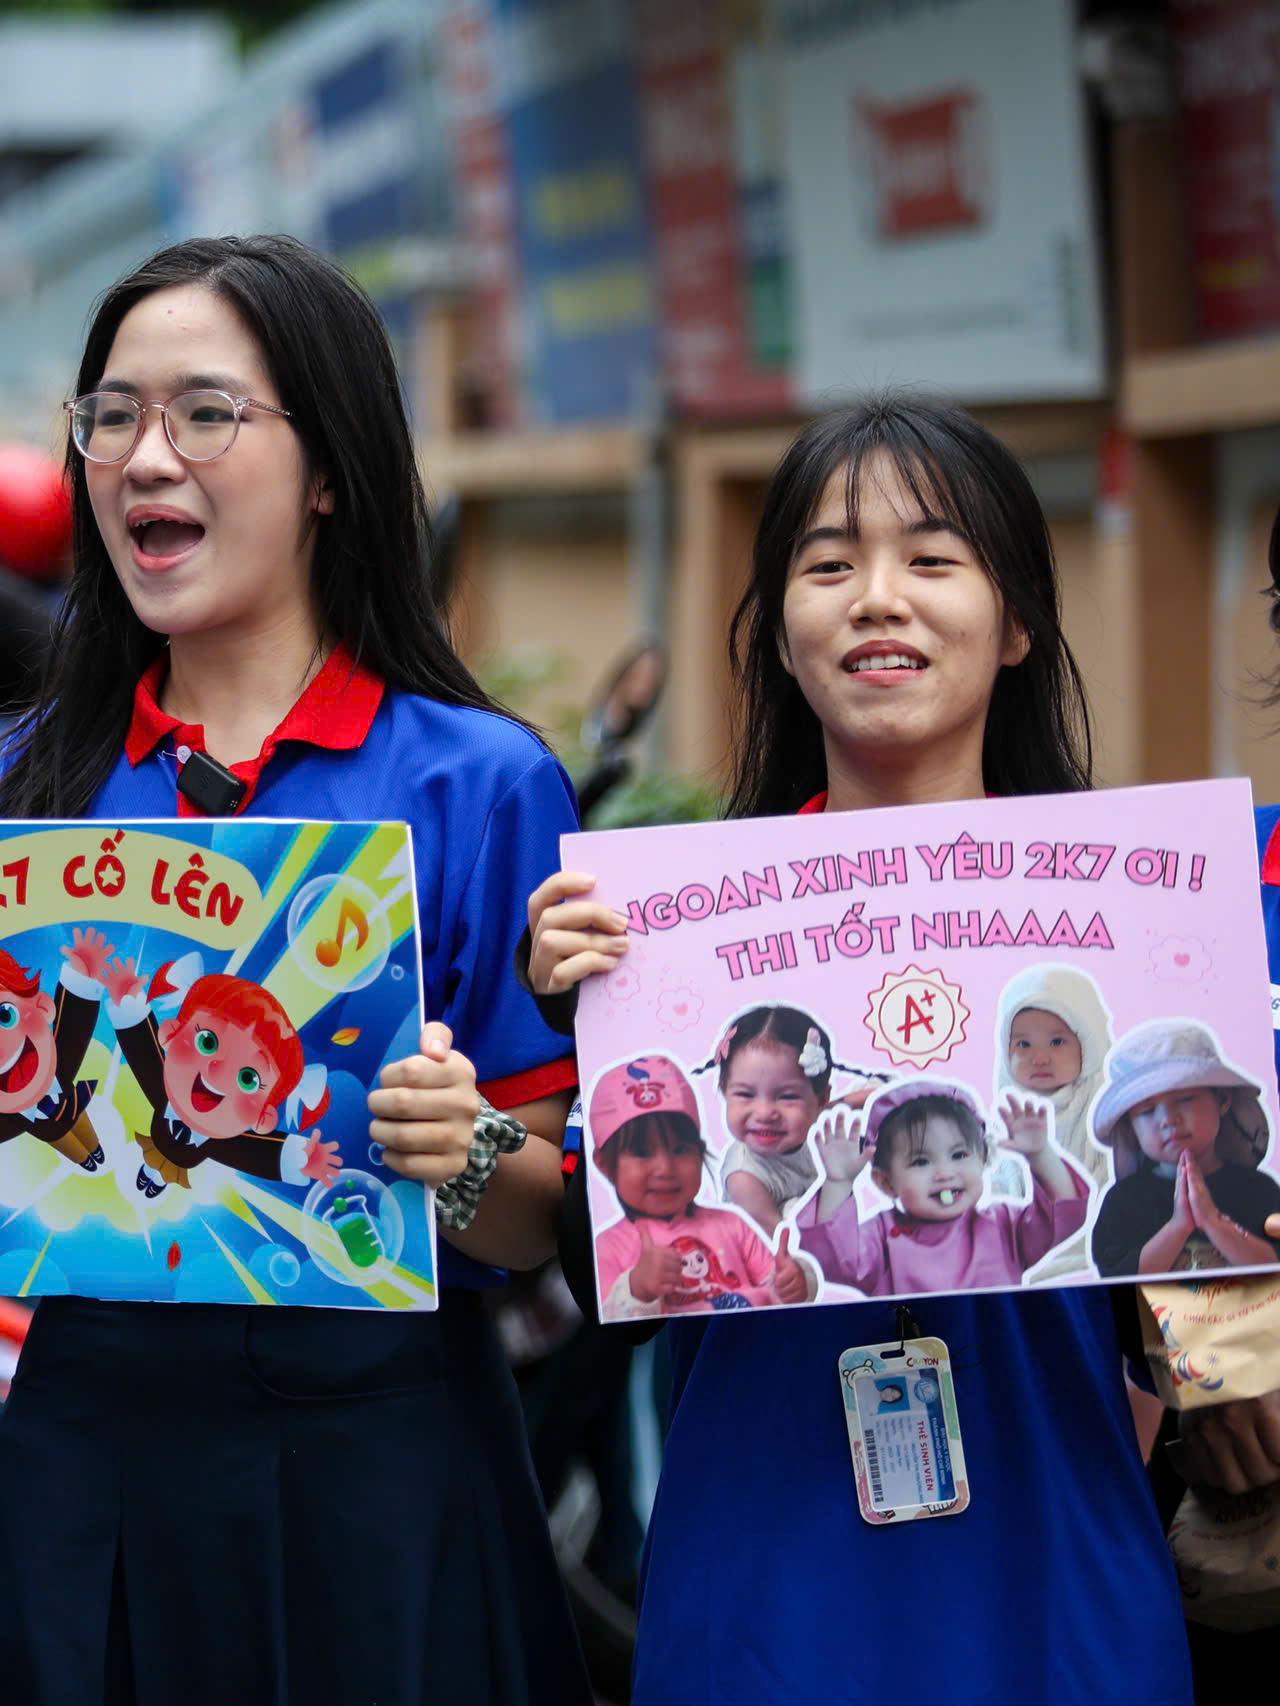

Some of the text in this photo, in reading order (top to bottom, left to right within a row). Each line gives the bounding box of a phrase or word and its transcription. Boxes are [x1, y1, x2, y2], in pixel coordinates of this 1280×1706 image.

[62, 828, 126, 898] CỐ
[150, 852, 245, 927] LÊN
[612, 831, 1206, 936] NGOAN XINH YÊU 2K7 ƠI !
[715, 902, 1115, 981] THI TỐT NHAAAA
[919, 1442, 929, 1466] SINH
[924, 1467, 934, 1491] VIÊN
